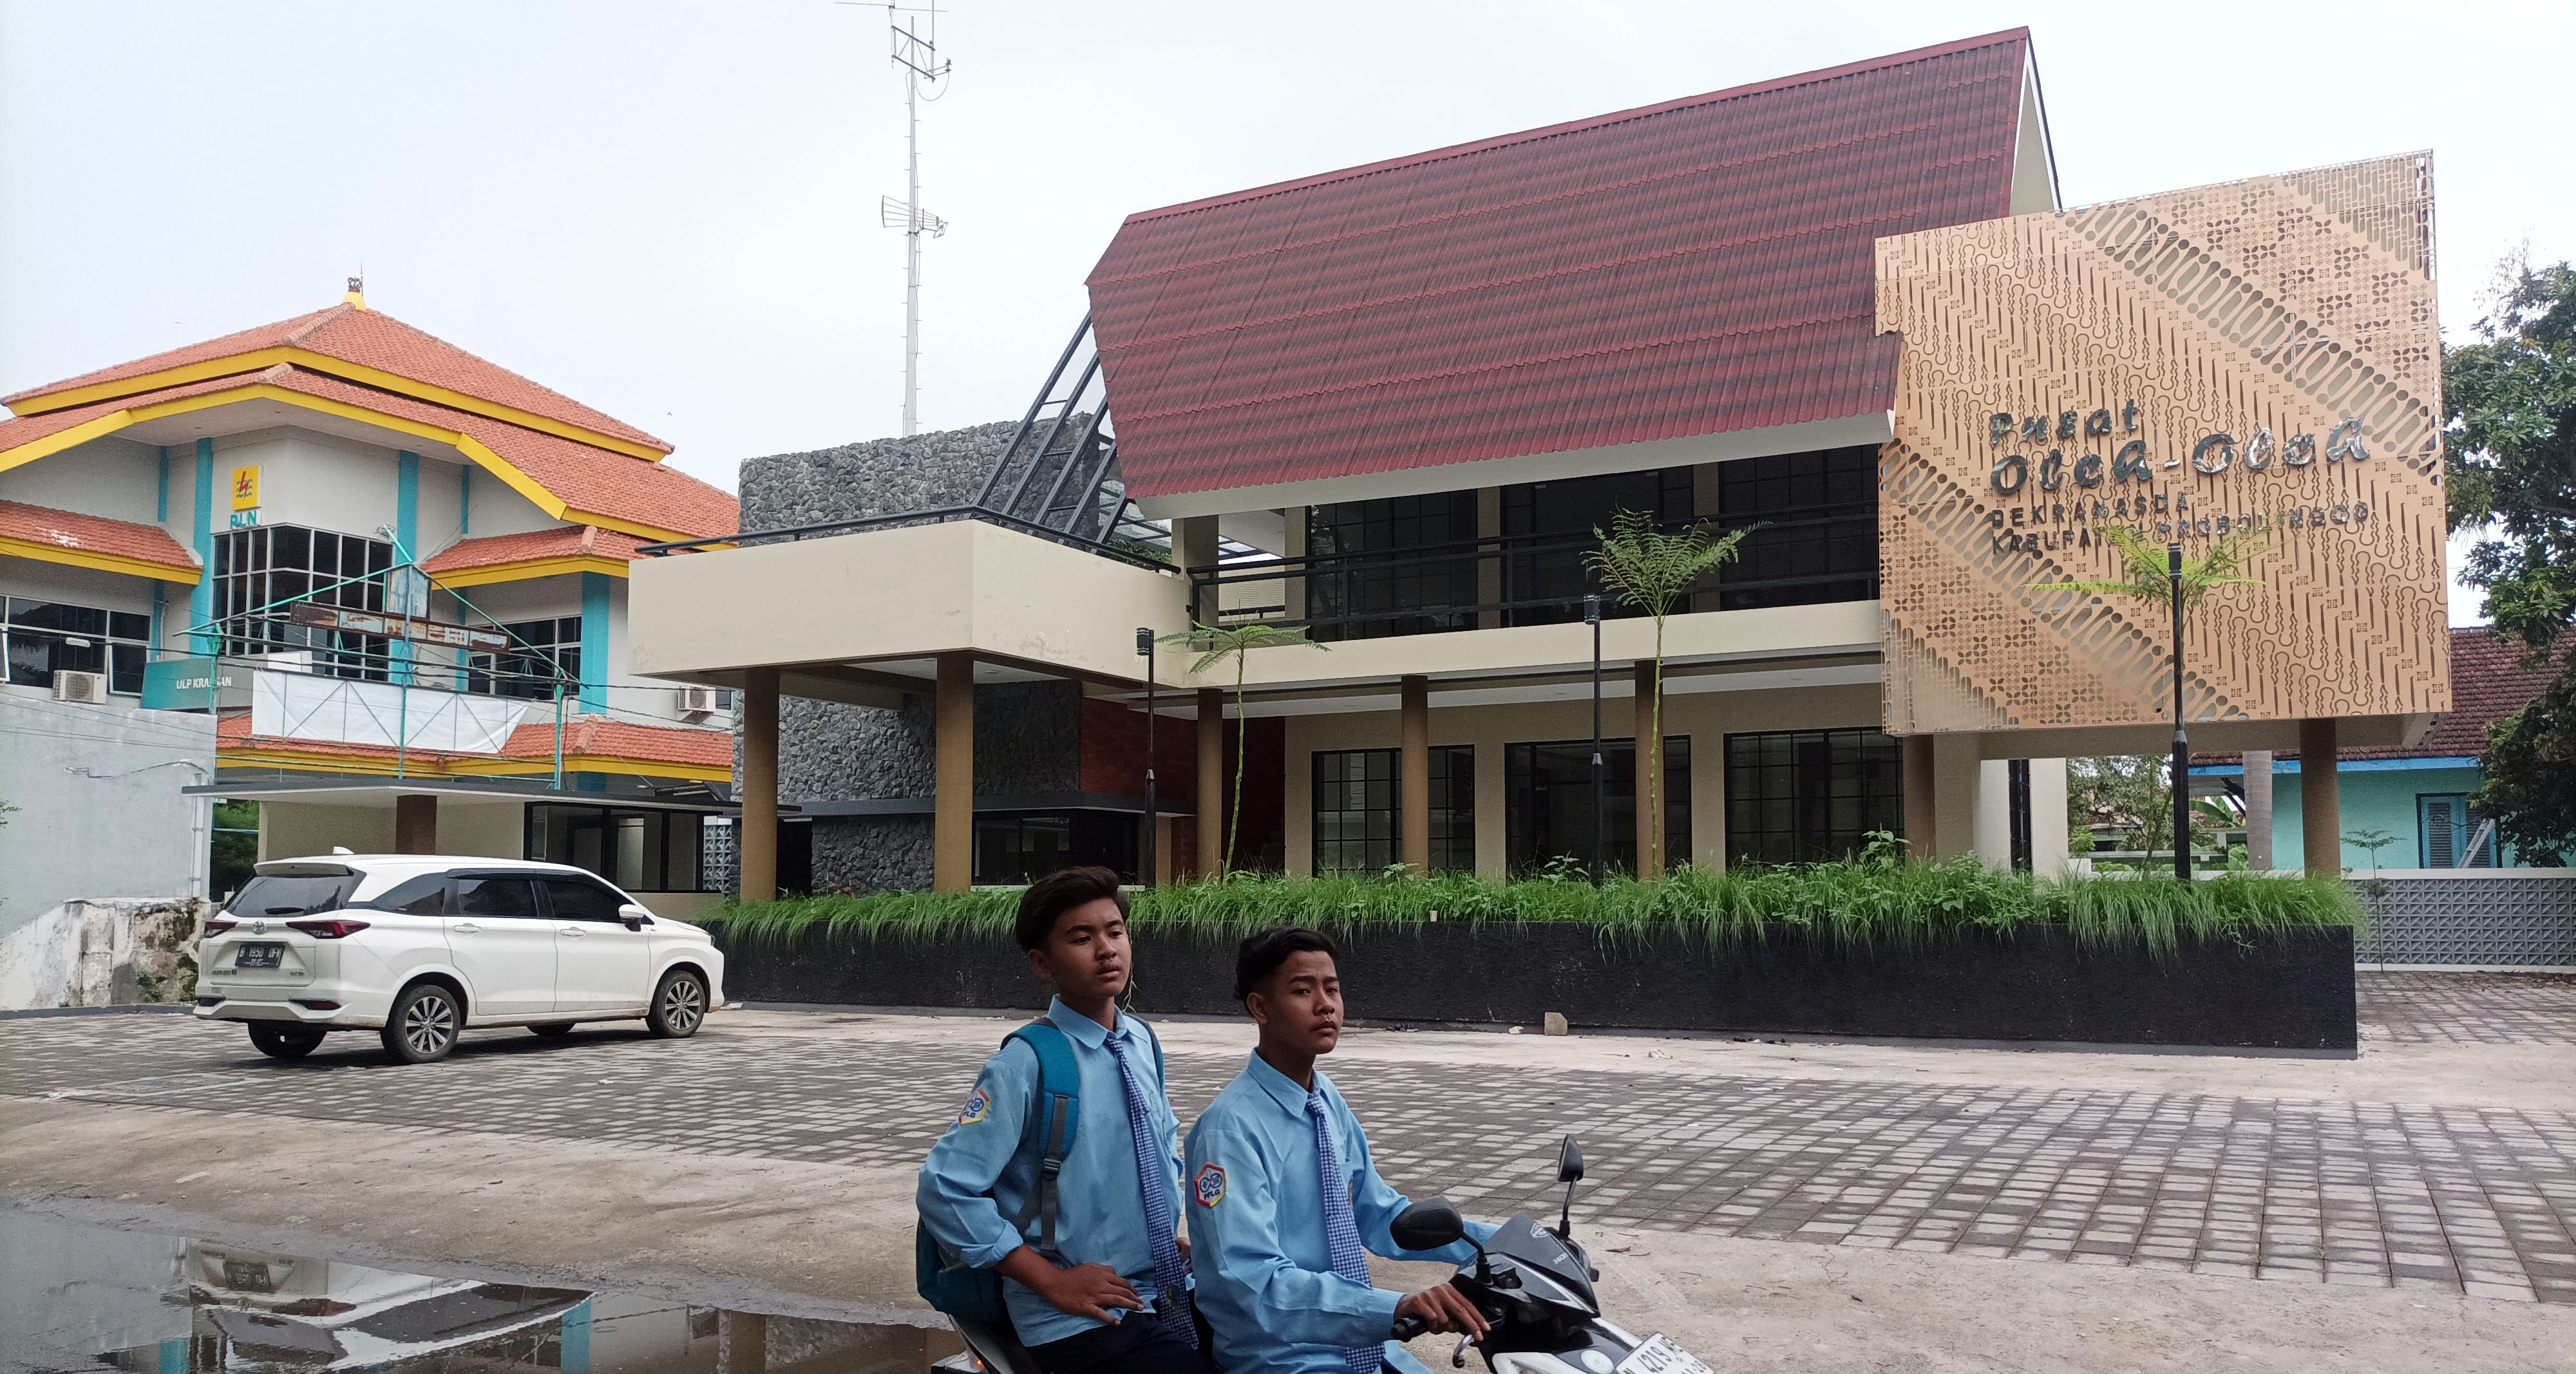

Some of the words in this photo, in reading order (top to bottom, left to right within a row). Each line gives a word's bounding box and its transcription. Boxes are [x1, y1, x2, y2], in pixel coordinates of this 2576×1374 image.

[1989, 399, 2139, 447] Pusat
[230, 509, 257, 529] PLN
[1991, 491, 2188, 529] DEKRANASDA
[1993, 522, 2143, 555] KABUPATN
[176, 679, 192, 689] ULP
[239, 947, 245, 957] B
[249, 947, 264, 957] 1950
